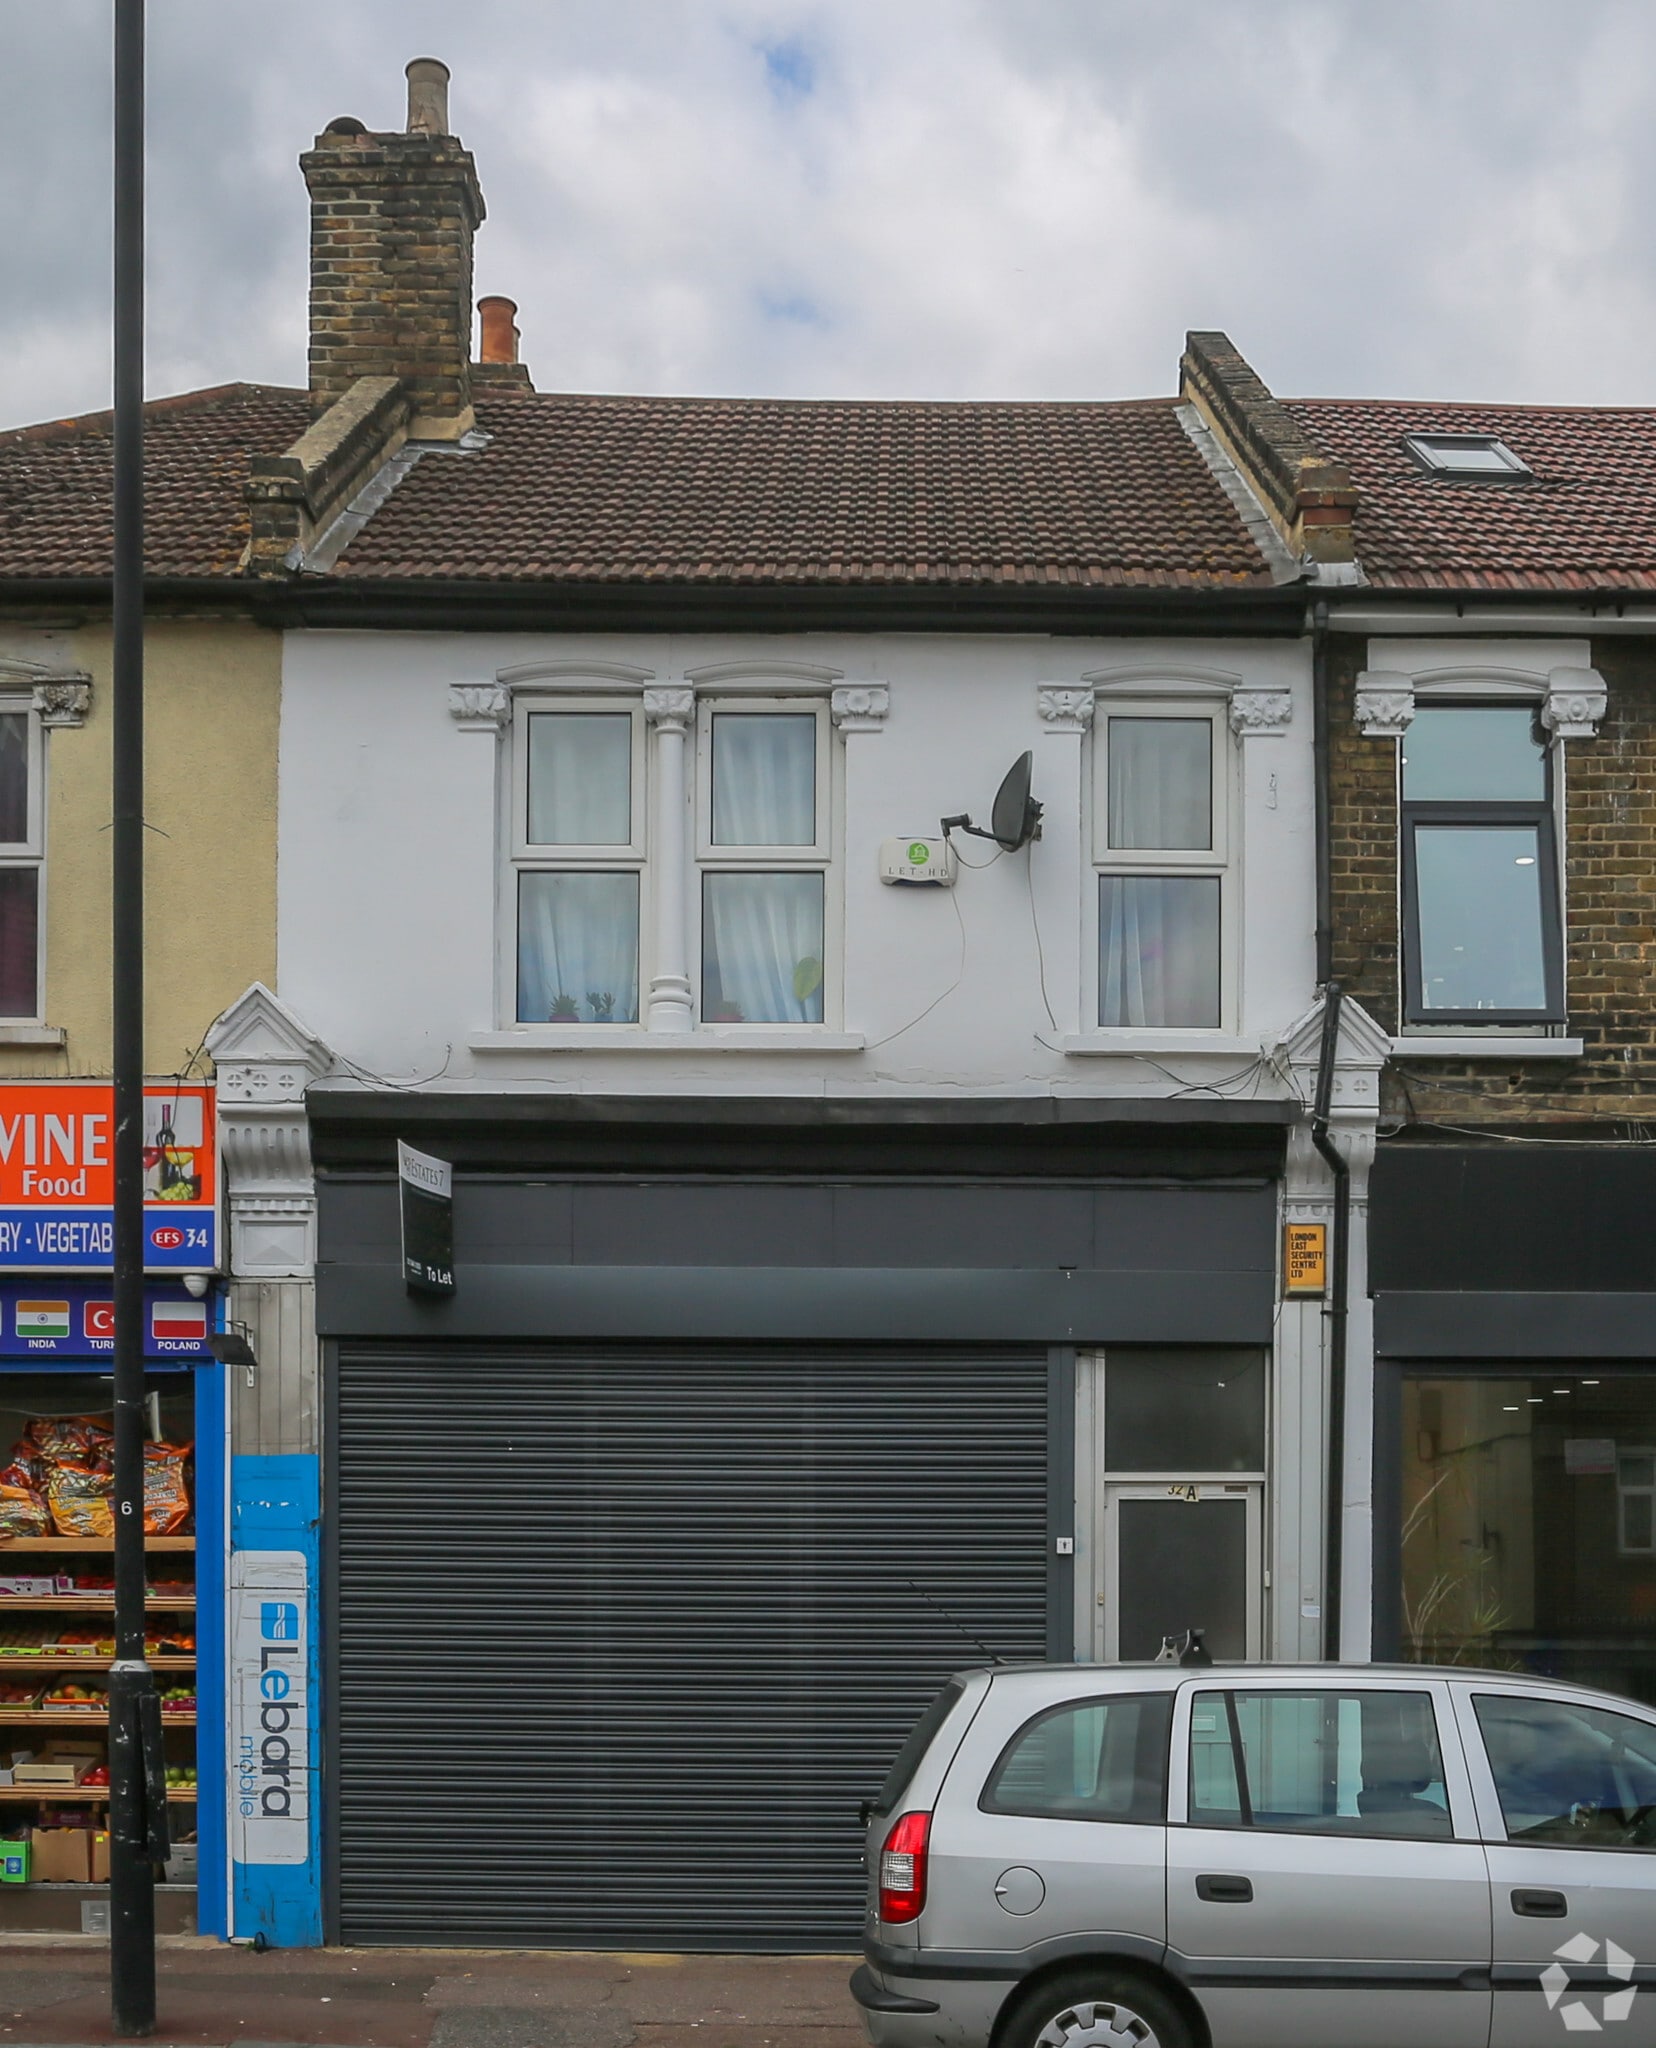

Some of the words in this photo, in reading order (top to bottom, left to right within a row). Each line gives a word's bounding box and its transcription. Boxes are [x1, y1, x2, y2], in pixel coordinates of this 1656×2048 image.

[22, 1168, 86, 1196] Food
[155, 1231, 180, 1244] EFS
[186, 1228, 208, 1248] 34
[1290, 1233, 1317, 1241] LONDON
[1290, 1242, 1307, 1250] EAST
[1290, 1252, 1323, 1260] SECURITY
[1290, 1261, 1317, 1269] CENTRE
[426, 1265, 437, 1282] To
[437, 1268, 453, 1285] Let
[1290, 1270, 1303, 1278] LTD
[28, 1339, 56, 1348] INDIA
[157, 1341, 200, 1351] POLAND
[121, 1501, 133, 1516] 6
[260, 1646, 299, 1817] Lebara
[239, 1735, 258, 1816] mobile
